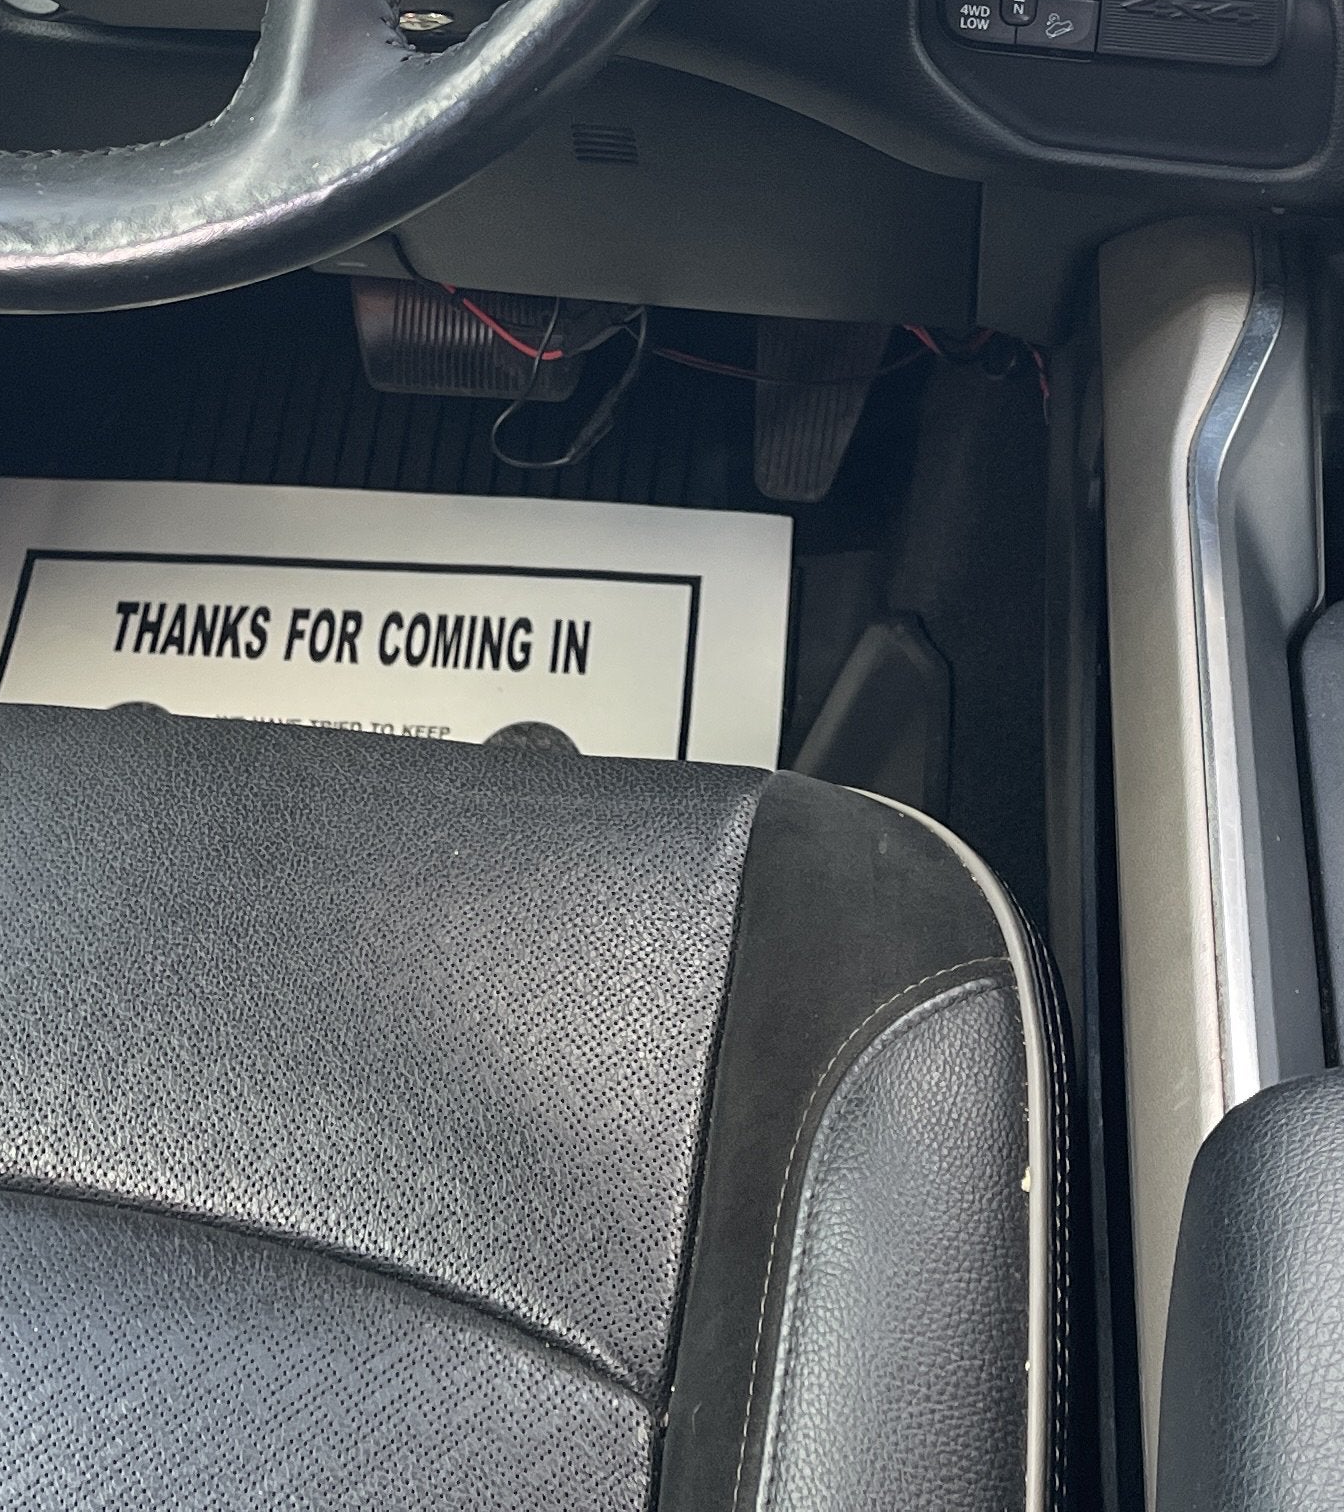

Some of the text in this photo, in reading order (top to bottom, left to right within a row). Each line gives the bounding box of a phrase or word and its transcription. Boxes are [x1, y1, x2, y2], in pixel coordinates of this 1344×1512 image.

[960, 4, 991, 17] 4WD
[1013, 3, 1024, 15] N
[960, 18, 990, 30] LOW
[113, 601, 593, 675] THANKS FOR COMING IN
[371, 722, 394, 734] TO
[402, 724, 451, 739] KEEP
